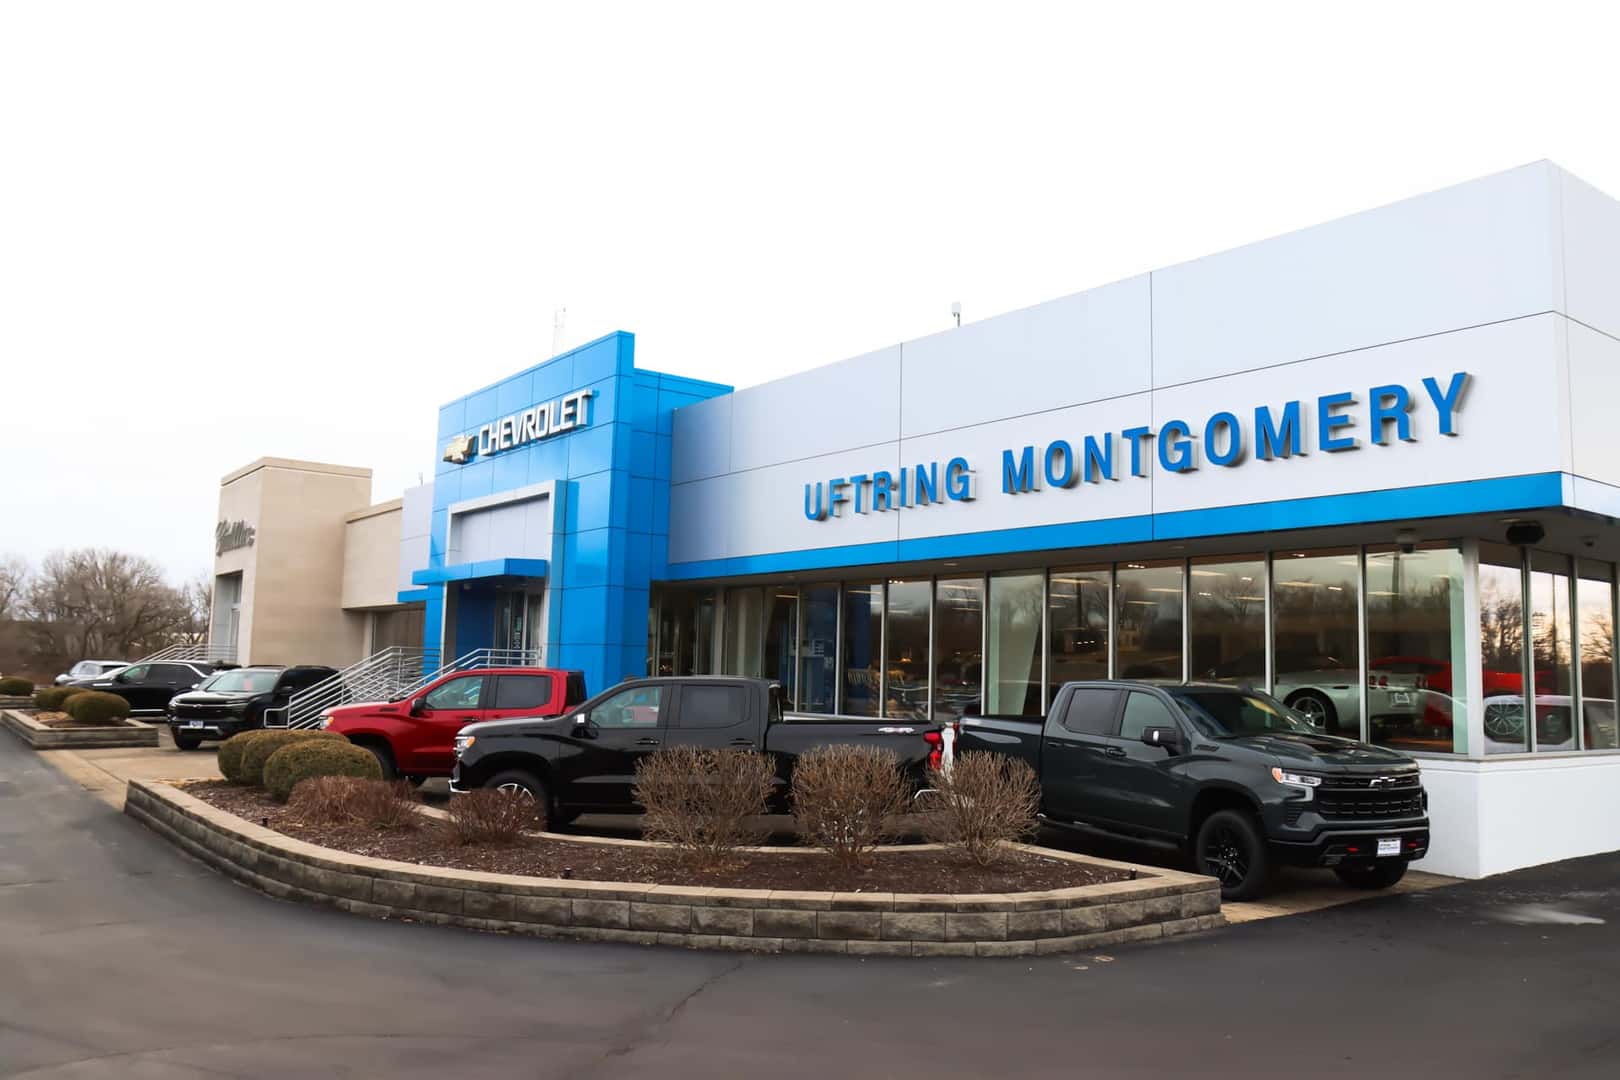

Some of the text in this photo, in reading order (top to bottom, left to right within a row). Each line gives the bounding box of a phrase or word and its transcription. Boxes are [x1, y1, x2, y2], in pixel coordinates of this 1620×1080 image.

[478, 389, 592, 456] CHEVROLET
[805, 372, 1475, 521] UFTRING MONTGOMERY
